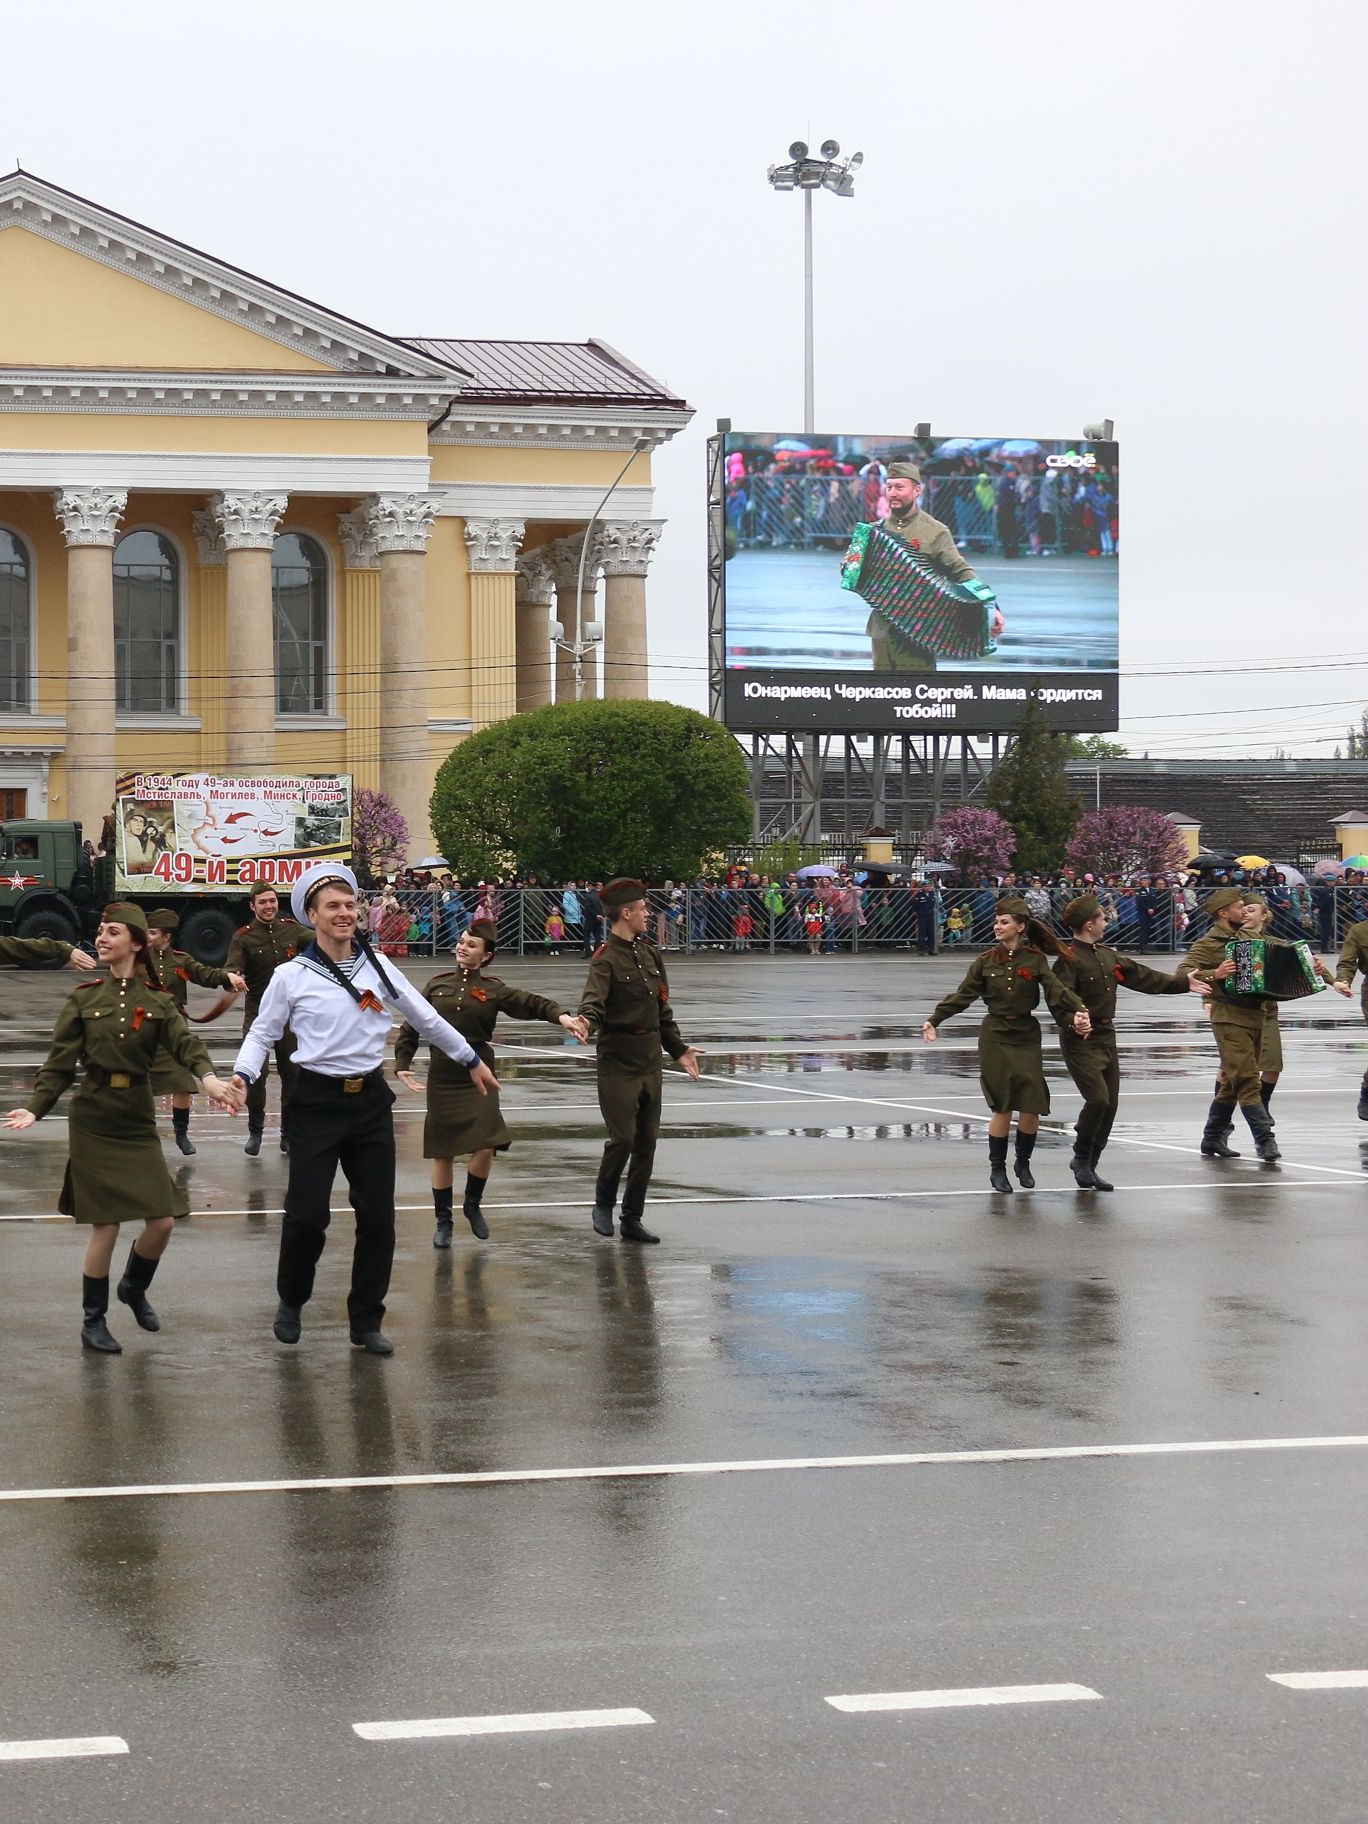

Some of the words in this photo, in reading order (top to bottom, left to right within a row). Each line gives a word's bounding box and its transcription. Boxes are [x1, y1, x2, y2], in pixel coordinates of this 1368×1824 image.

[744, 683, 831, 700] Юнармеец
[834, 684, 911, 701] Черкасов
[915, 684, 978, 702] Сергей.
[982, 685, 1027, 700] Мама
[1031, 688, 1102, 703] ордится
[894, 704, 956, 718] тобой!!!
[136, 777, 144, 787] В
[147, 777, 173, 787] 1944
[177, 779, 200, 790] году
[203, 778, 235, 788] 49-ая
[239, 779, 301, 789] освободила
[304, 780, 340, 790] города
[137, 789, 205, 800] Мстиславль,
[210, 790, 259, 800] Могилев,
[263, 790, 301, 801] Минск,
[305, 791, 342, 801] Гродно
[154, 853, 225, 883] 49-й
[239, 859, 343, 884] арм
